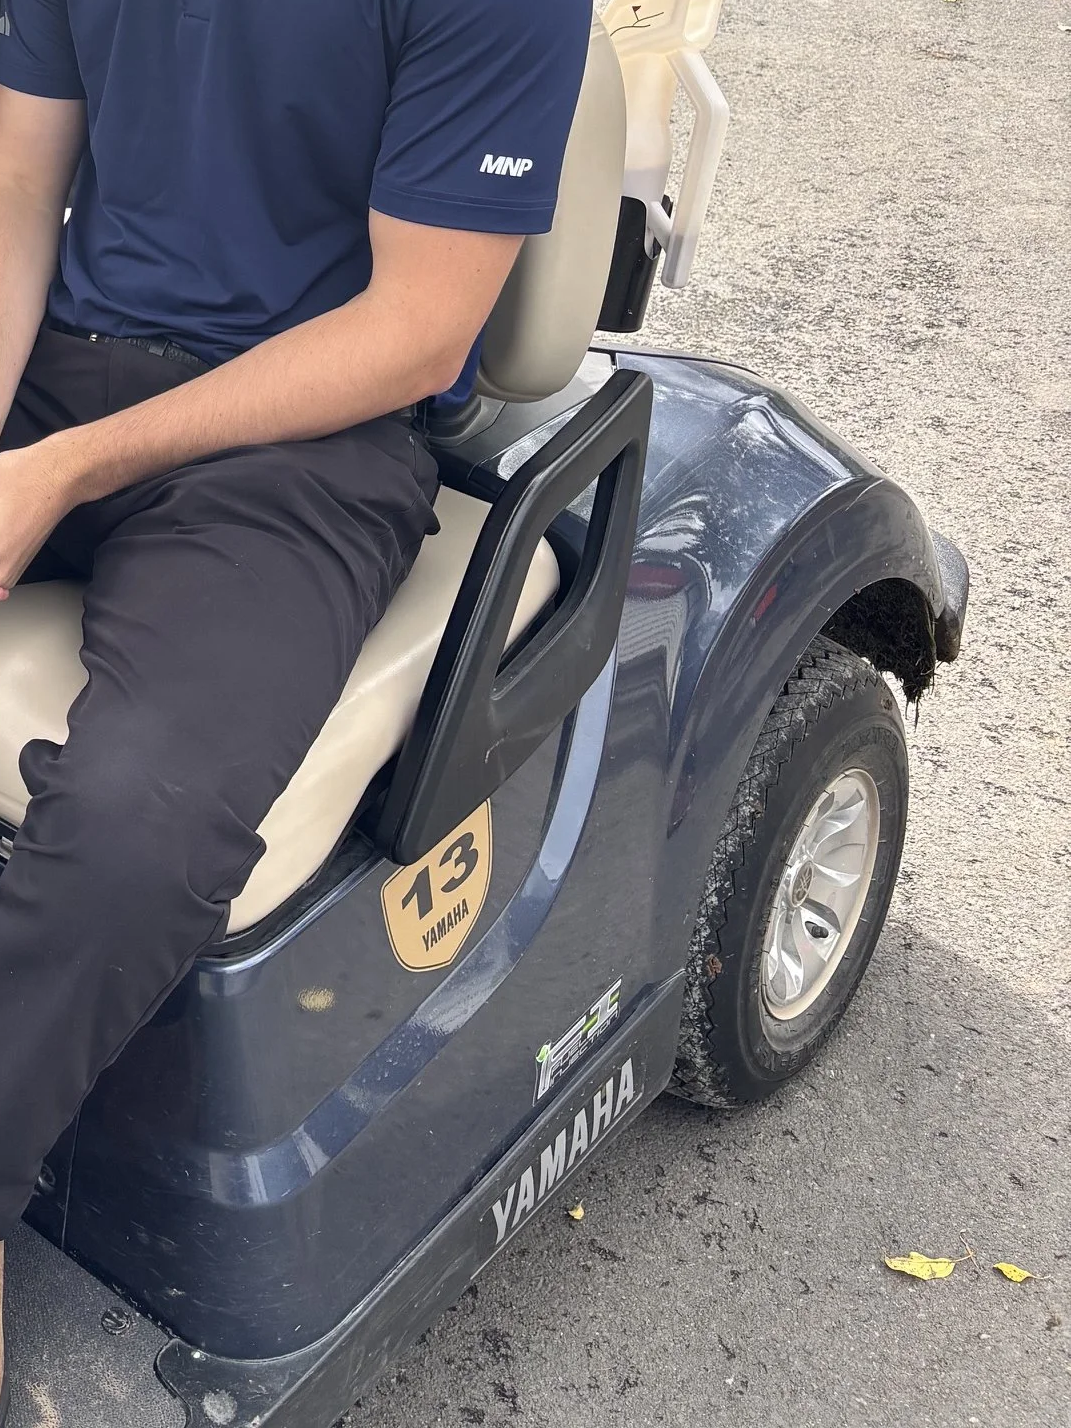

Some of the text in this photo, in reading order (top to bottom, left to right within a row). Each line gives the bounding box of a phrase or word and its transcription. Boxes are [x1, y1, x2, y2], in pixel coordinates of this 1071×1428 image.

[480, 154, 533, 177] MNP
[401, 832, 479, 920] 13
[422, 898, 469, 952] YAMAHA
[550, 1038, 588, 1077] FUEL
[492, 1057, 636, 1245] YAMAHA
